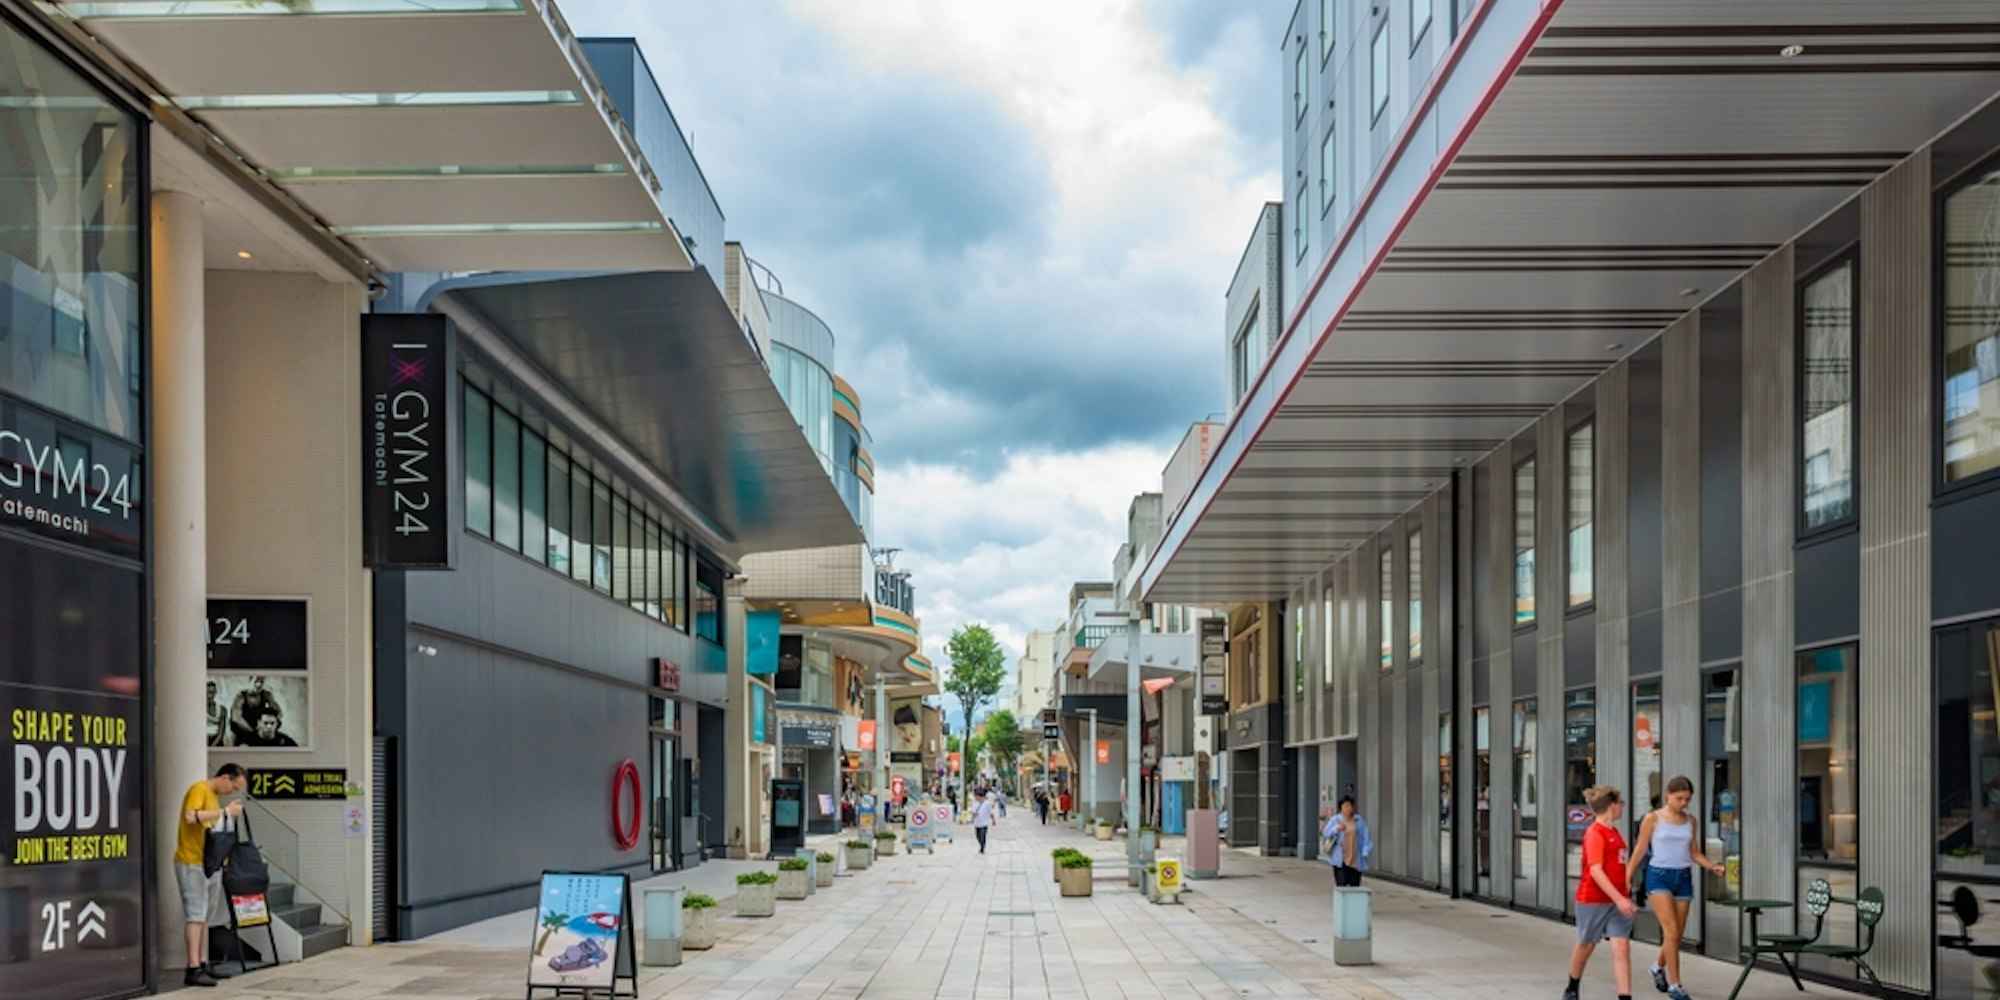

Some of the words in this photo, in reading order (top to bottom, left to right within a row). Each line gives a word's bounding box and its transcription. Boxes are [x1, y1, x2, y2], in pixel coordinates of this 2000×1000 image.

[375, 394, 388, 487] Tatemachi
[0, 495, 89, 535] atemachi
[12, 708, 74, 743] SHAPE
[81, 714, 127, 746] YOUR
[15, 744, 127, 832] BODY
[252, 773, 273, 795] 2F
[14, 838, 44, 864] JOIN
[46, 837, 70, 862] THE
[71, 836, 100, 860] BEST
[102, 834, 128, 858] GYM
[41, 900, 71, 952] 2F
